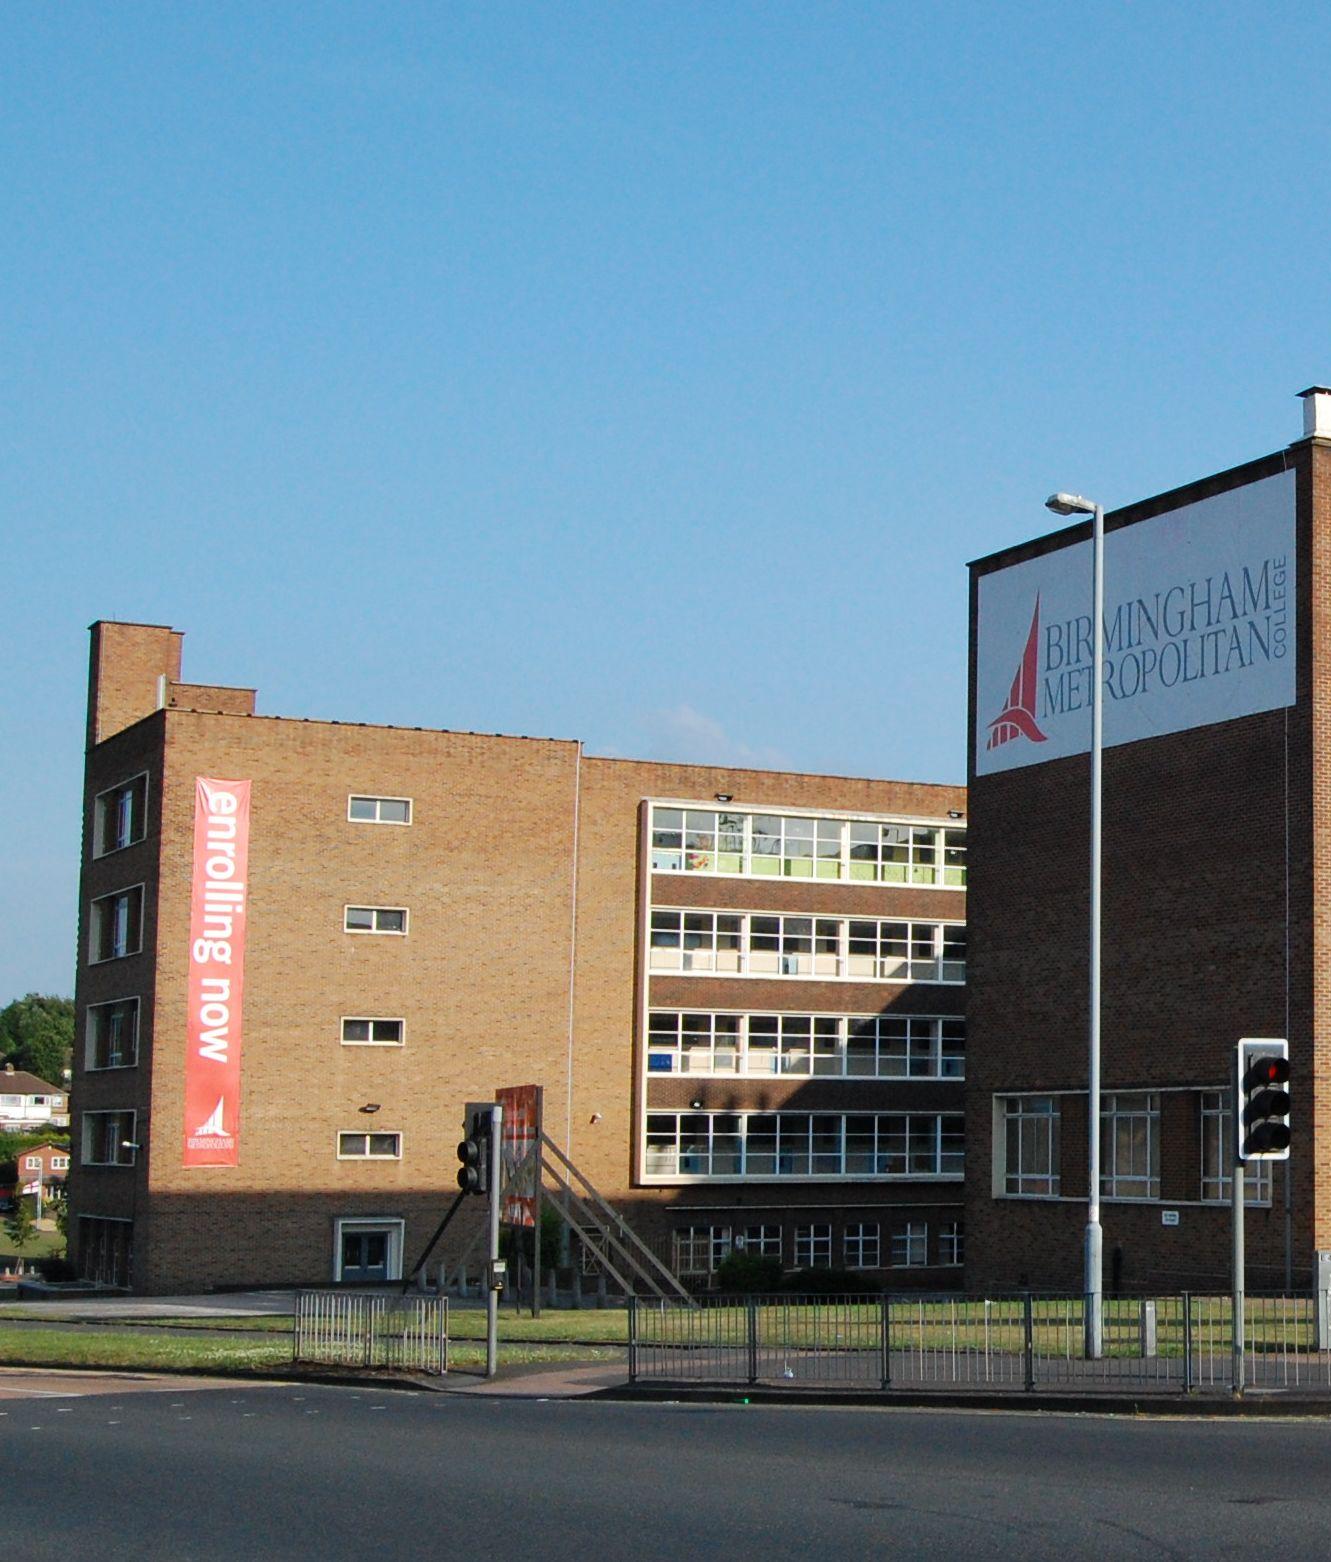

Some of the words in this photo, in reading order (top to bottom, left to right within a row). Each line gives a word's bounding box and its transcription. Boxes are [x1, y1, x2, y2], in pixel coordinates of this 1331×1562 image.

[1045, 559, 1273, 673] BIRMINGHAM
[1273, 555, 1287, 659] COLLEGE
[1043, 616, 1272, 718] METROPOLITAN
[193, 791, 245, 965] enrolling
[199, 978, 231, 1064] now
